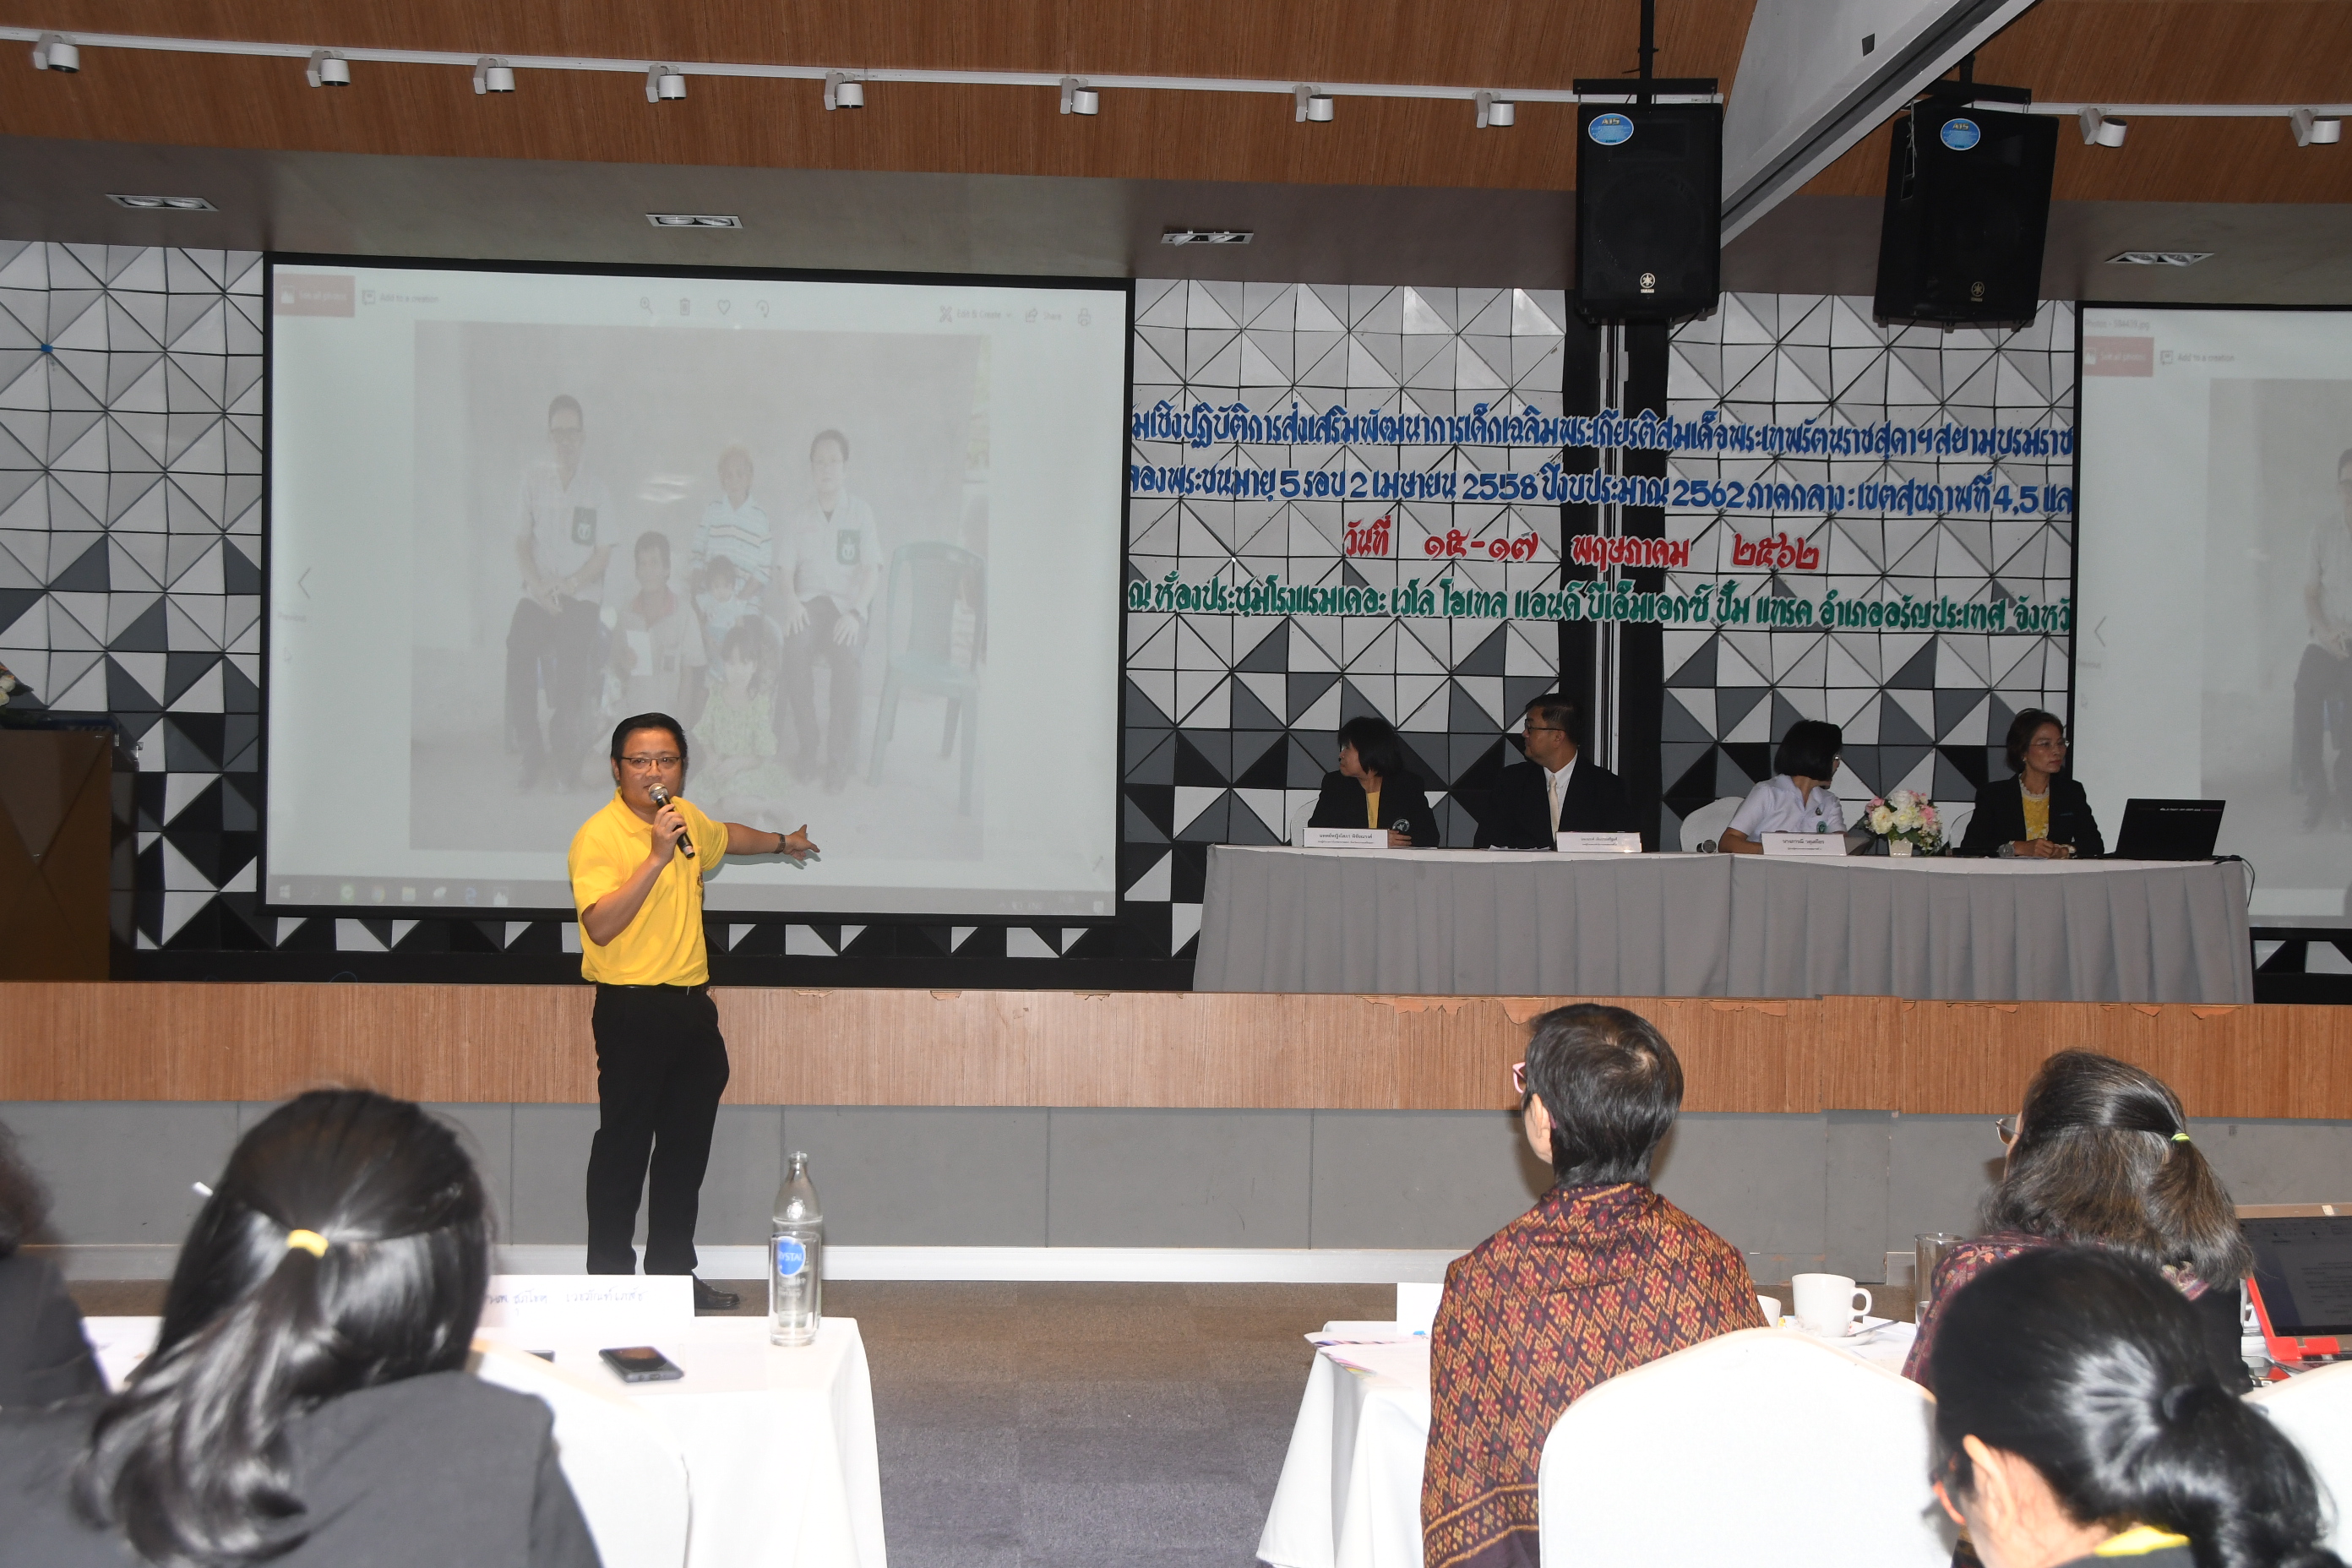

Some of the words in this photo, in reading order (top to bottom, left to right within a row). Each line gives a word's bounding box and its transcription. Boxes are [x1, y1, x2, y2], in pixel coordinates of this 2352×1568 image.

[1280, 470, 1302, 498] 5
[1304, 470, 1346, 498] รอบ
[1350, 471, 1368, 498] 2
[1373, 469, 1457, 500] เมษายน
[1462, 471, 1538, 502] 2558
[1671, 479, 1745, 509] 2562
[1344, 514, 1392, 557] วันที่
[1572, 534, 1690, 572] พฤษภาคม
[1733, 531, 1821, 571] ๒๕๖๒
